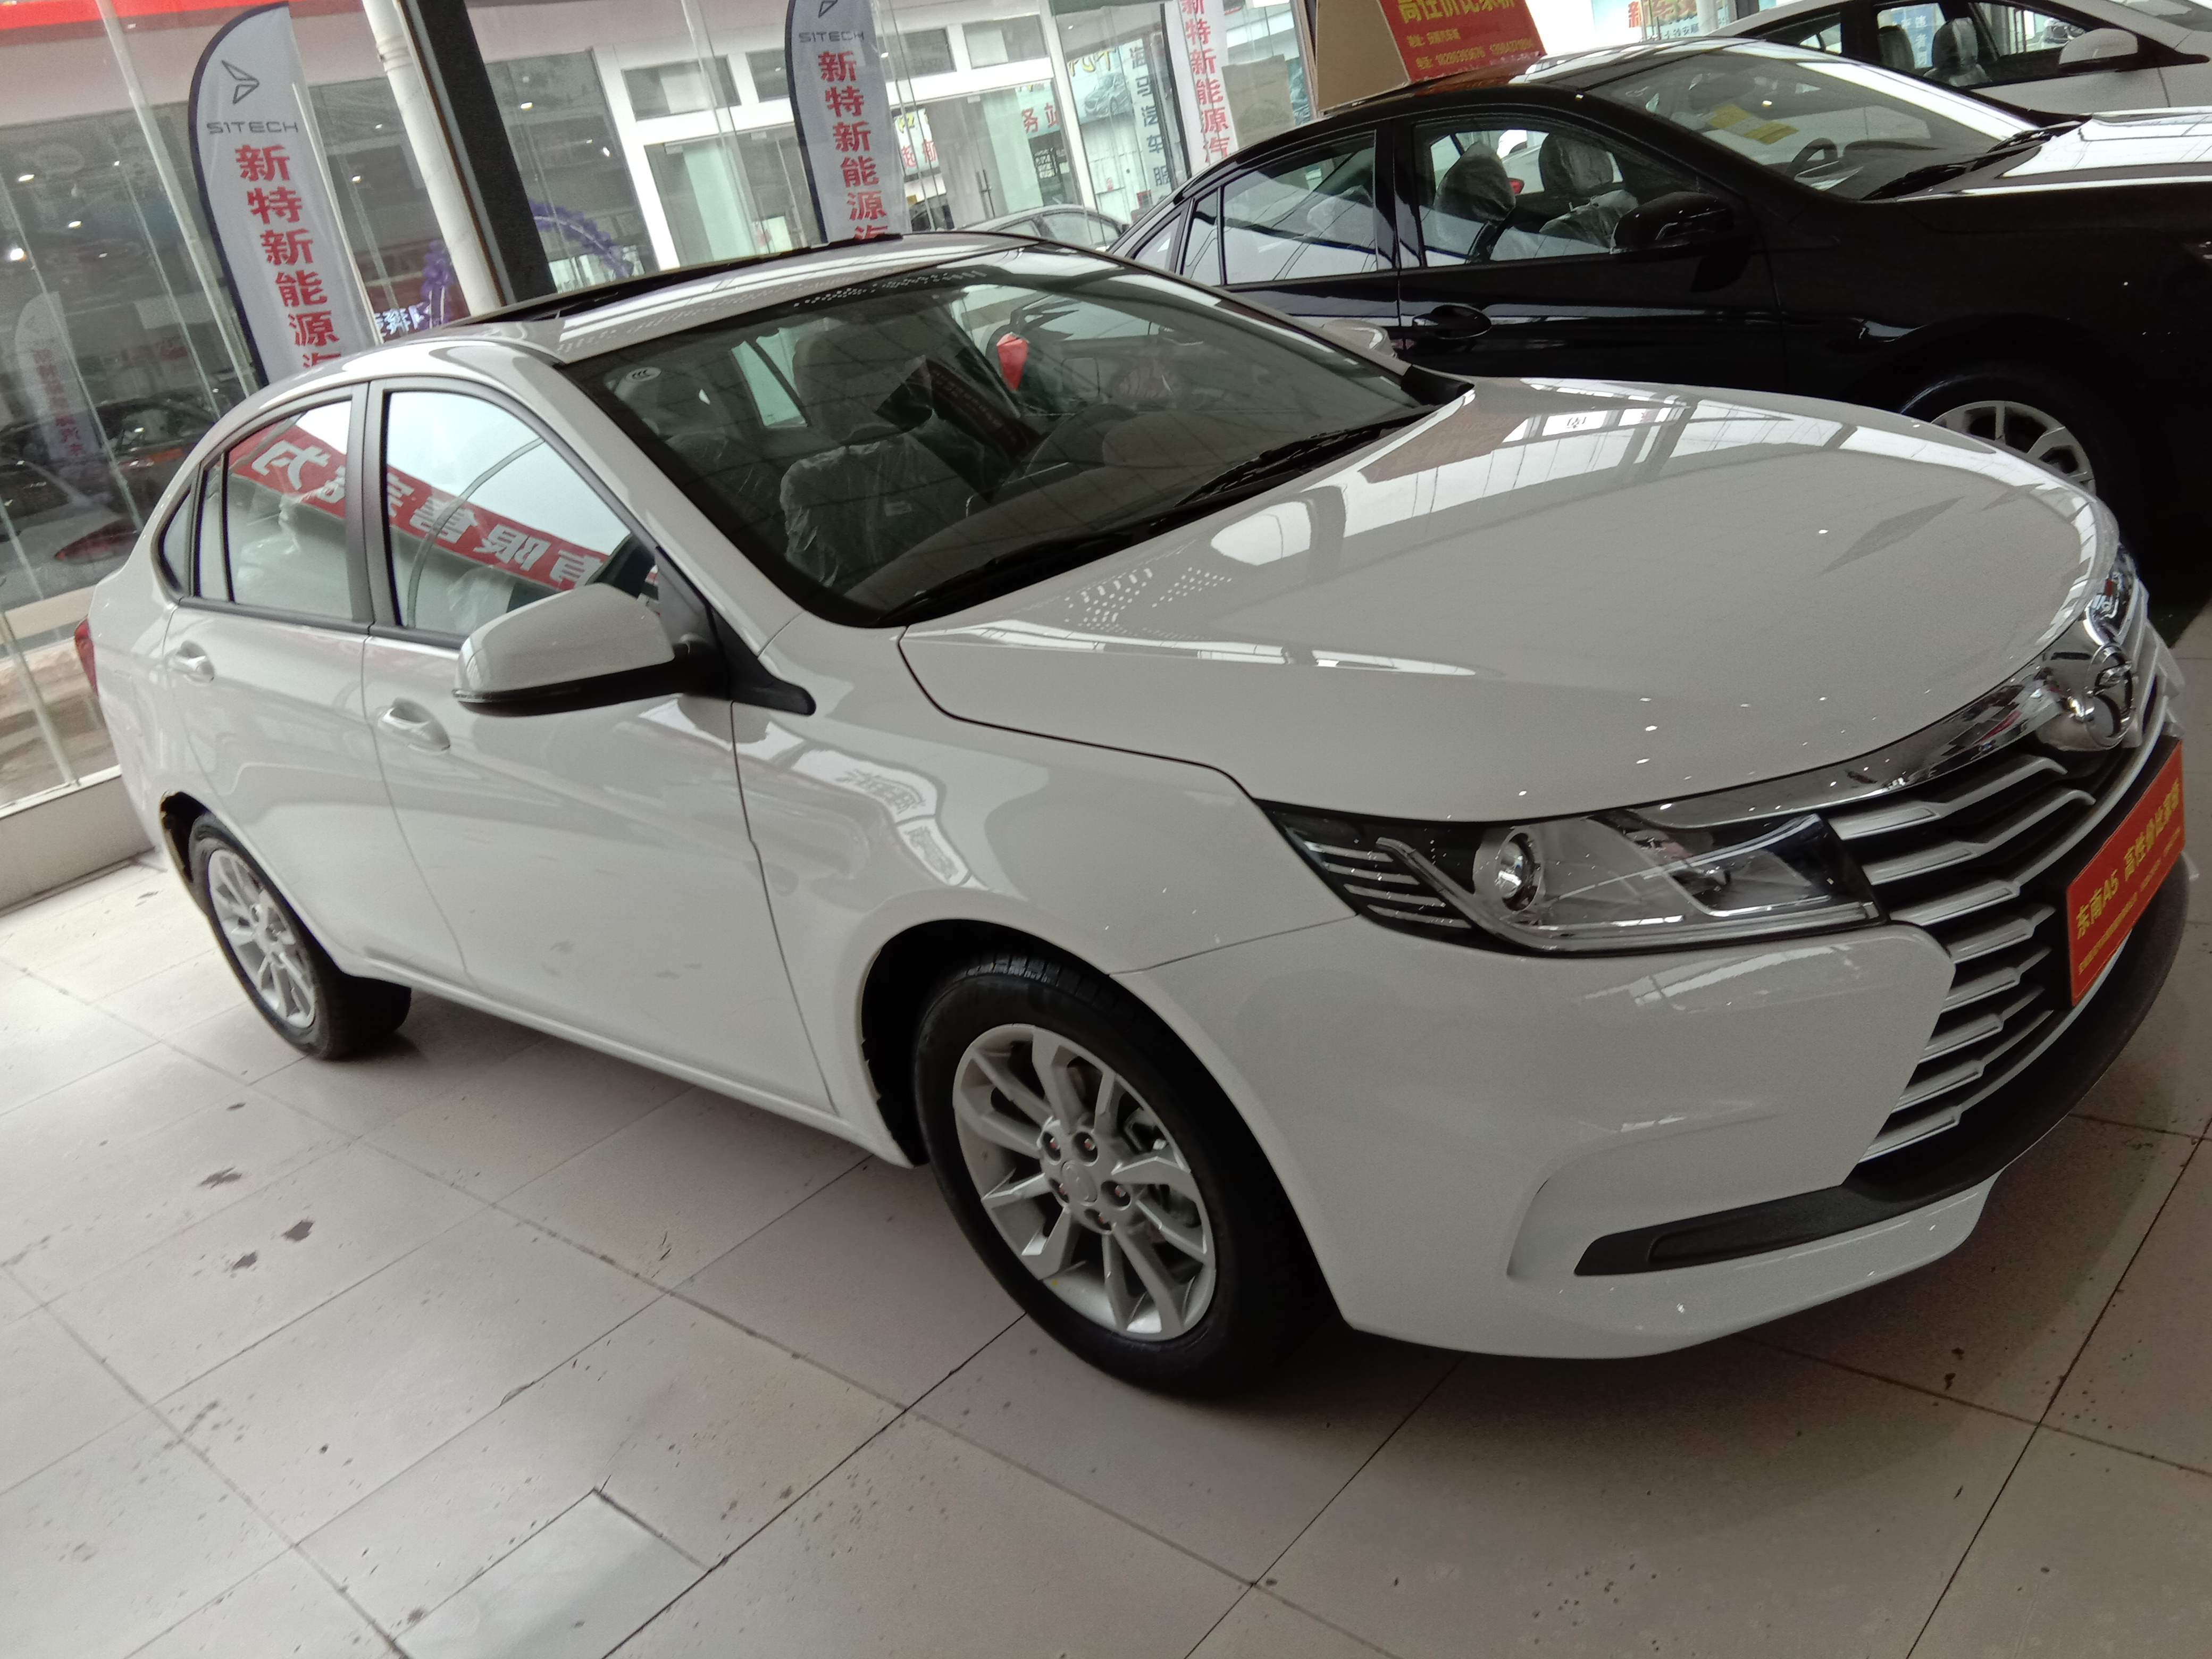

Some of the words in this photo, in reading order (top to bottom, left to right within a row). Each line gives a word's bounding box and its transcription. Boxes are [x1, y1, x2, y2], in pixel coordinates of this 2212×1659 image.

[799, 30, 865, 43] SITECH
[206, 120, 299, 135] SITECH
[2076, 868, 2119, 940] 东南A5
